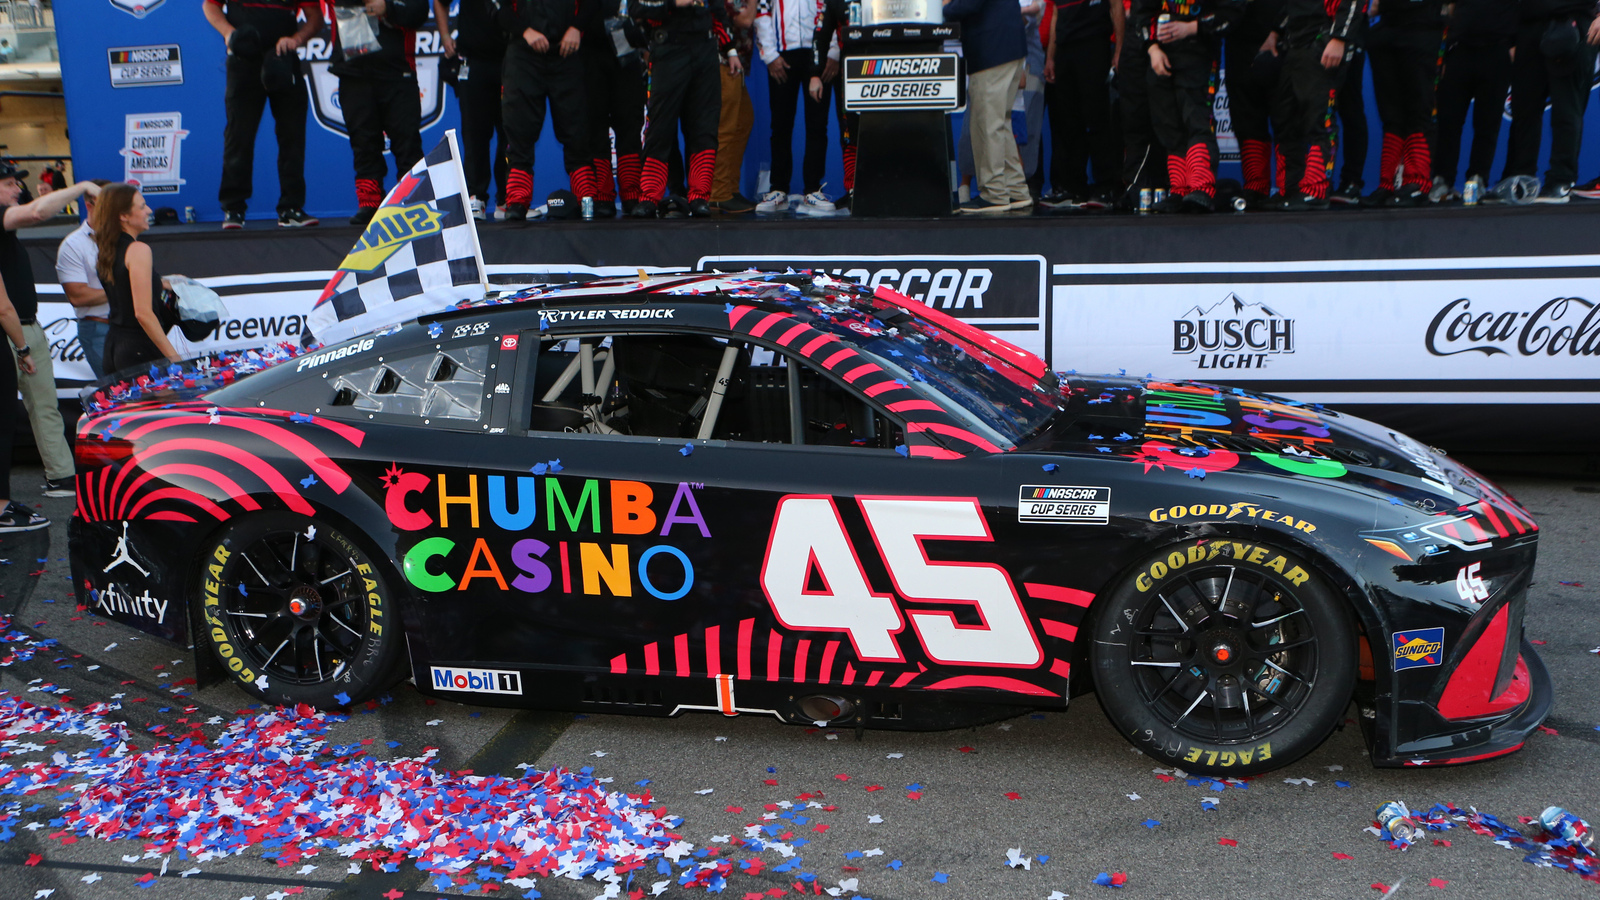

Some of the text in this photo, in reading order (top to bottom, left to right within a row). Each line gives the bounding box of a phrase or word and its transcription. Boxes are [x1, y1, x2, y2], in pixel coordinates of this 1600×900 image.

[131, 49, 169, 63] NASCAR
[120, 65, 172, 79] CUP SERIES
[880, 58, 941, 75] NASCAR
[861, 83, 941, 98] CUP SERIES
[143, 119, 174, 129] NASCAR
[132, 136, 167, 149] CIRCUIT
[131, 156, 169, 169] AMERICAS
[560, 310, 606, 320] TYLER
[608, 309, 675, 319] REDDICK
[1172, 318, 1295, 354] BUSCH
[297, 337, 375, 373] Pinnacle
[1197, 354, 1267, 369] LIGHT
[380, 462, 712, 538] CHUMBA
[1048, 487, 1098, 500] NASCAR
[1030, 502, 1098, 516] CUP SERIES
[402, 536, 694, 601] CASINO
[759, 494, 1045, 670] 45
[1456, 561, 1490, 604] 45
[96, 582, 168, 624] xfinity
[356, 562, 383, 637] EAGLE
[1396, 643, 1441, 656] SUNOCO
[434, 669, 514, 691] Mobil 1
[1183, 742, 1273, 767] EAGLE
